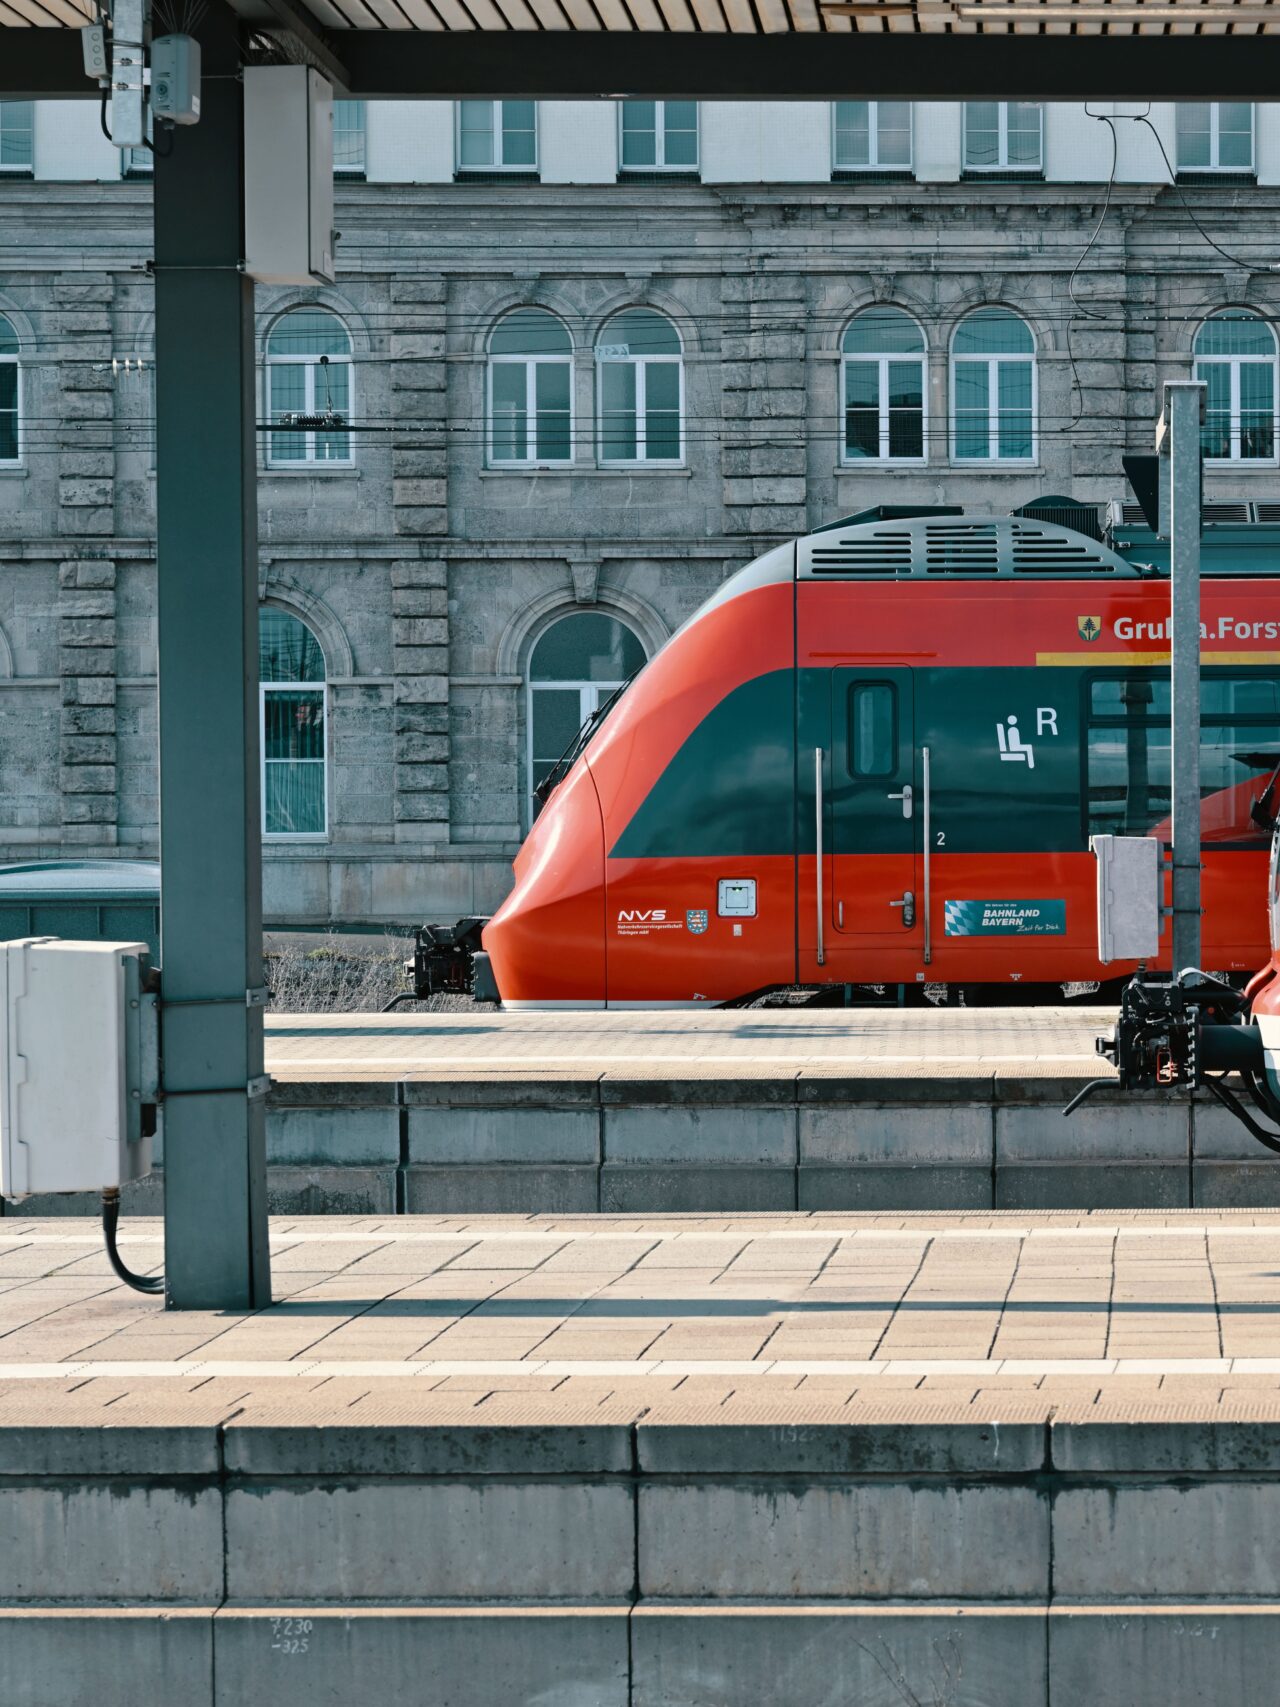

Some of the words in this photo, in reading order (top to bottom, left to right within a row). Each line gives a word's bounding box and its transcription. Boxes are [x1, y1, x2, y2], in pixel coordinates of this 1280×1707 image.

[1036, 707, 1059, 736] R
[936, 831, 946, 846] 2
[617, 909, 667, 921] NVS
[983, 909, 1040, 918] BAHNLAND
[982, 918, 1024, 926] BAYERN
